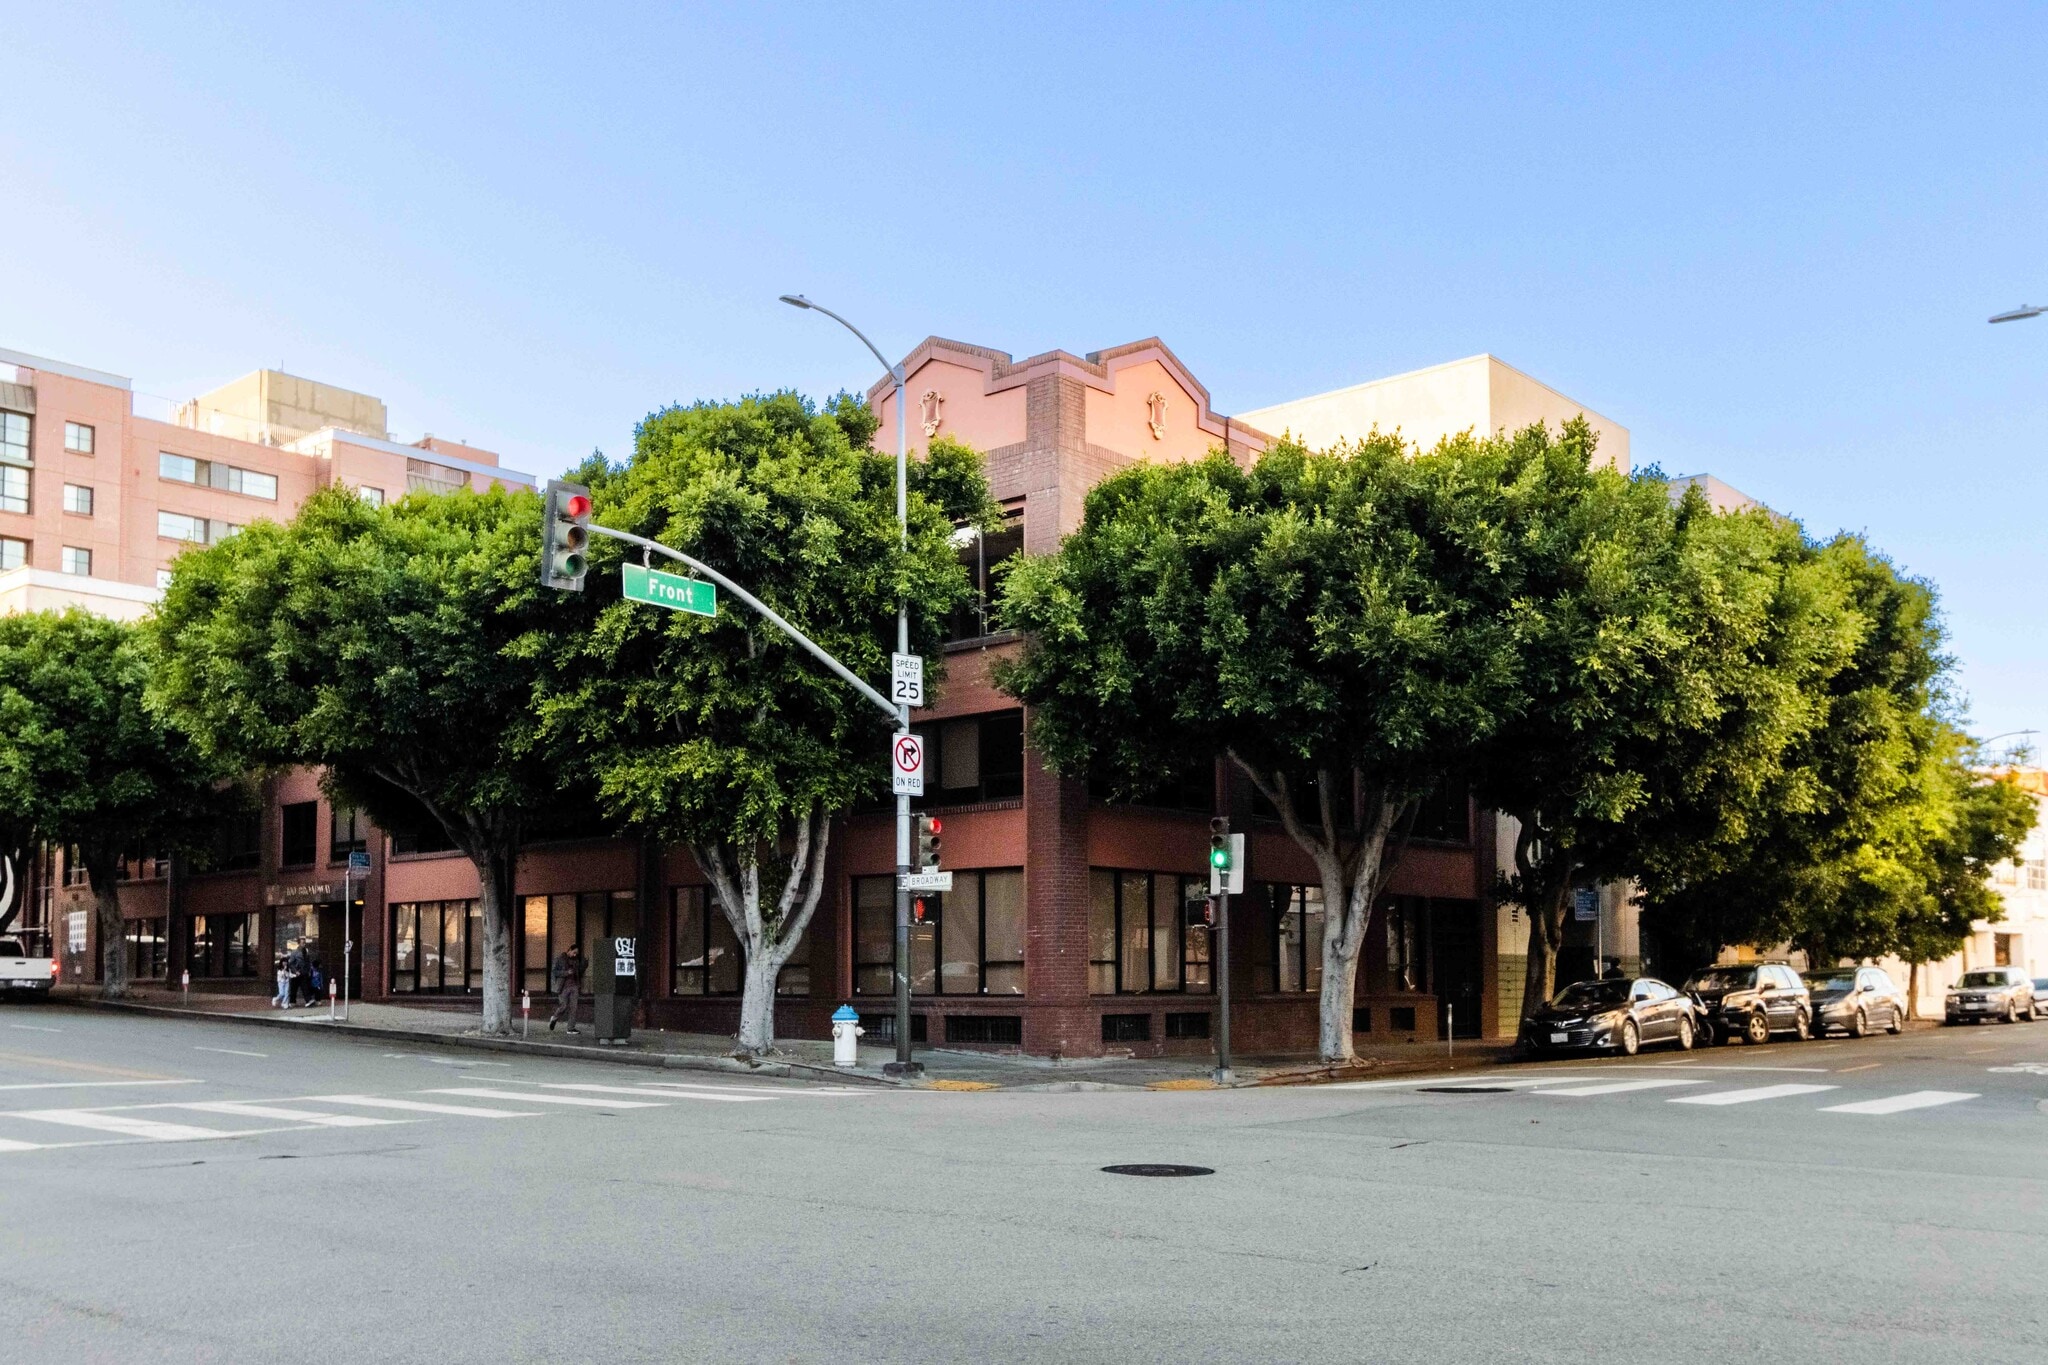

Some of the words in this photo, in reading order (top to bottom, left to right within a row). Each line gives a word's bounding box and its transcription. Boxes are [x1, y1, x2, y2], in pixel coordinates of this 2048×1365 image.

[649, 578, 693, 604] Front
[895, 659, 919, 670] SPEED
[897, 670, 917, 679] LIMIT
[896, 680, 919, 699] 25
[895, 776, 905, 786] ON
[907, 778, 921, 788] RED
[911, 876, 948, 885] BROADWAY
